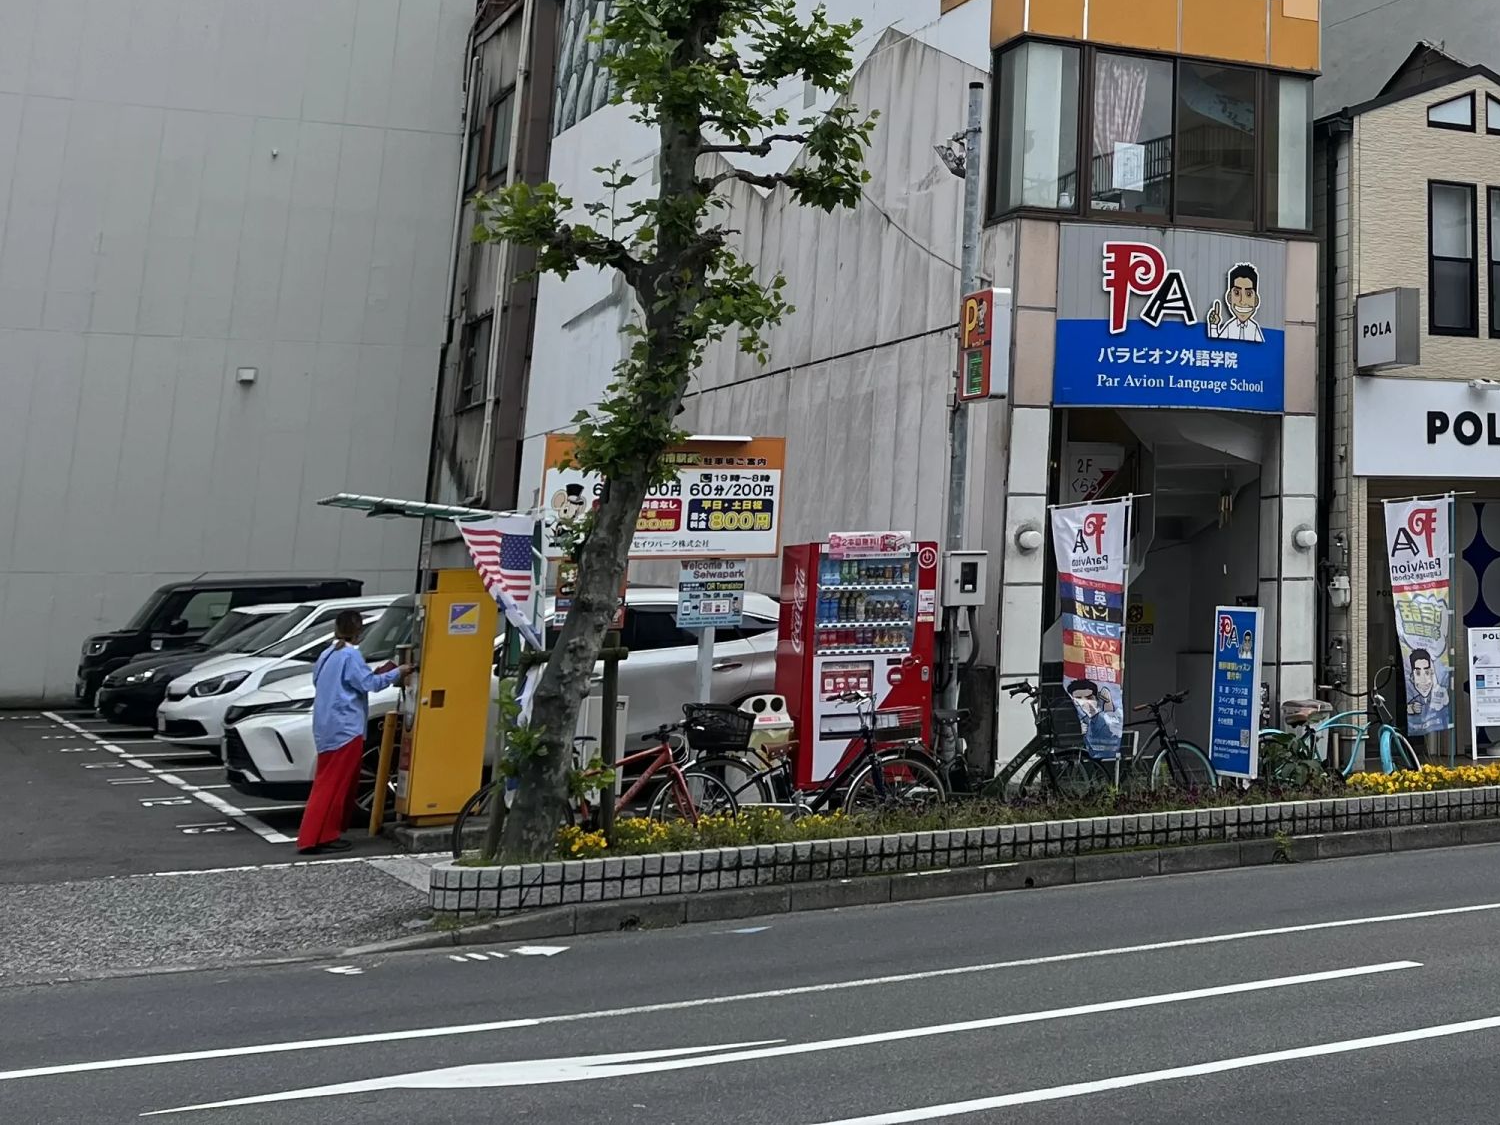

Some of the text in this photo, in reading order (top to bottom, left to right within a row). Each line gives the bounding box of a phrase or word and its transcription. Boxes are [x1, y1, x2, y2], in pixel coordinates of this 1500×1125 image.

[1363, 320, 1392, 338] POLA
[1098, 346, 1238, 369] パラビオン外語学院
[1097, 374, 1264, 393] Par Avion Language School
[1077, 458, 1093, 473] 2F
[690, 484, 774, 497] 60分/200円
[701, 500, 763, 511] 平日・土日祝
[708, 511, 772, 531] 800円
[681, 560, 722, 570] Welcome
